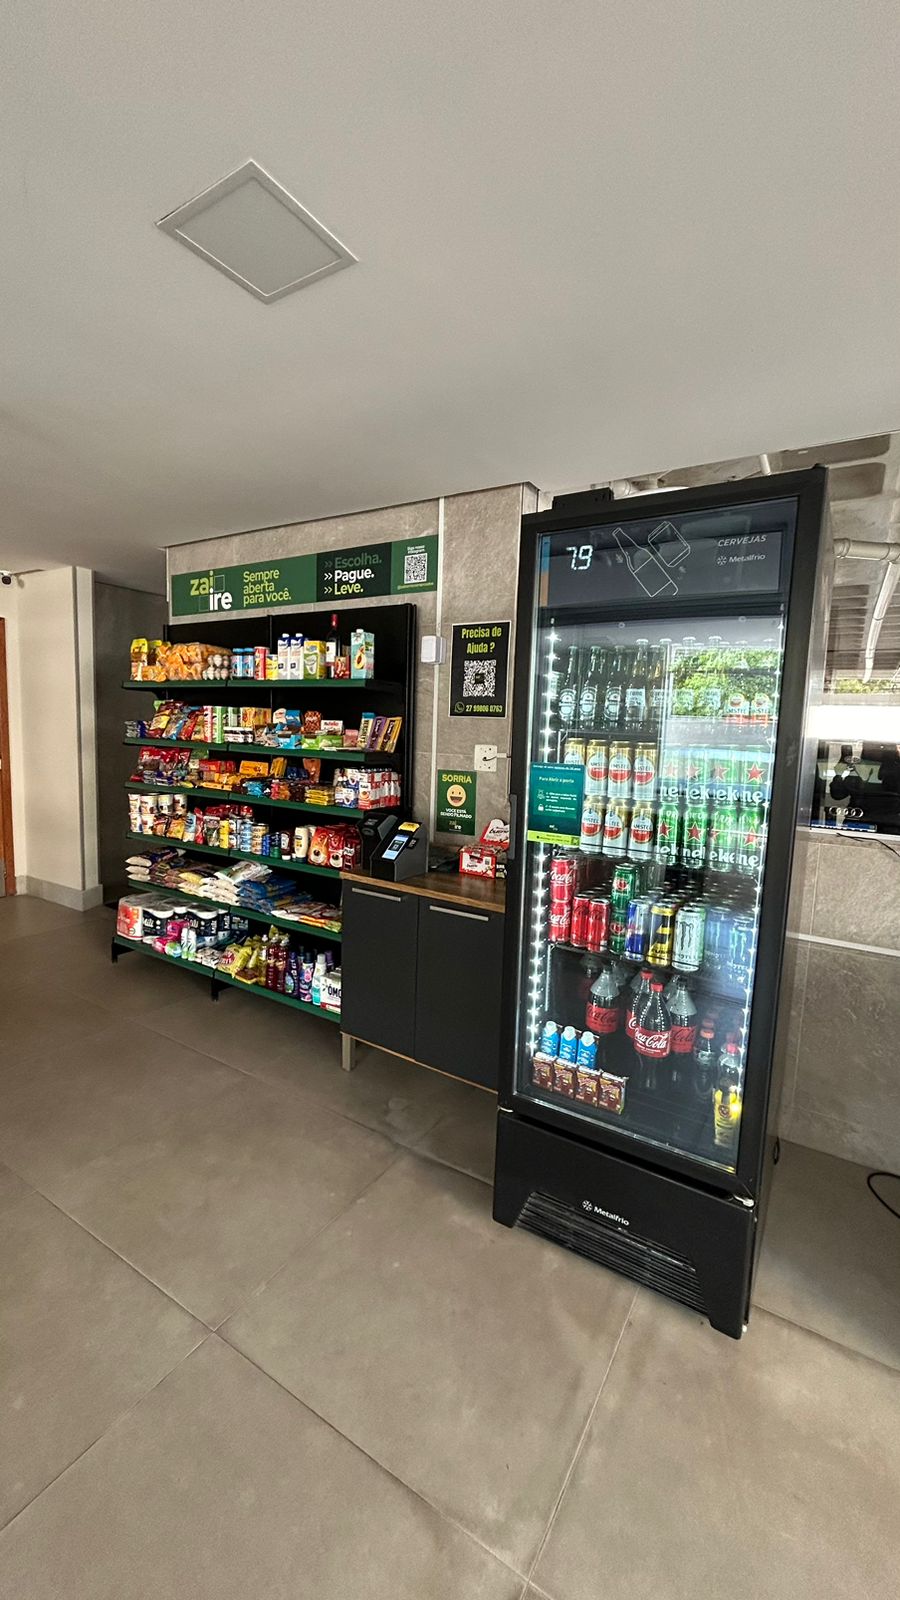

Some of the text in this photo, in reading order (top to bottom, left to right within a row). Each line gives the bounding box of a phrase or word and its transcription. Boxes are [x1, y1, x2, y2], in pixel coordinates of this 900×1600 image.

[718, 535, 768, 547] CERVEJAS
[334, 552, 382, 569] Escolha.
[729, 554, 766, 563] Metalfrio
[243, 569, 280, 584] Sempre
[334, 567, 375, 584] Pague.
[190, 571, 214, 596] zai
[243, 582, 275, 595] aberta
[334, 581, 364, 596] Leve.
[209, 587, 233, 611] ire
[243, 588, 292, 607] para você.
[461, 626, 502, 638] Precisa de
[466, 643, 488, 654] Ajuda
[466, 704, 473, 712] 27
[441, 774, 472, 784] SORRIA
[594, 1206, 630, 1226] Metalfrio
